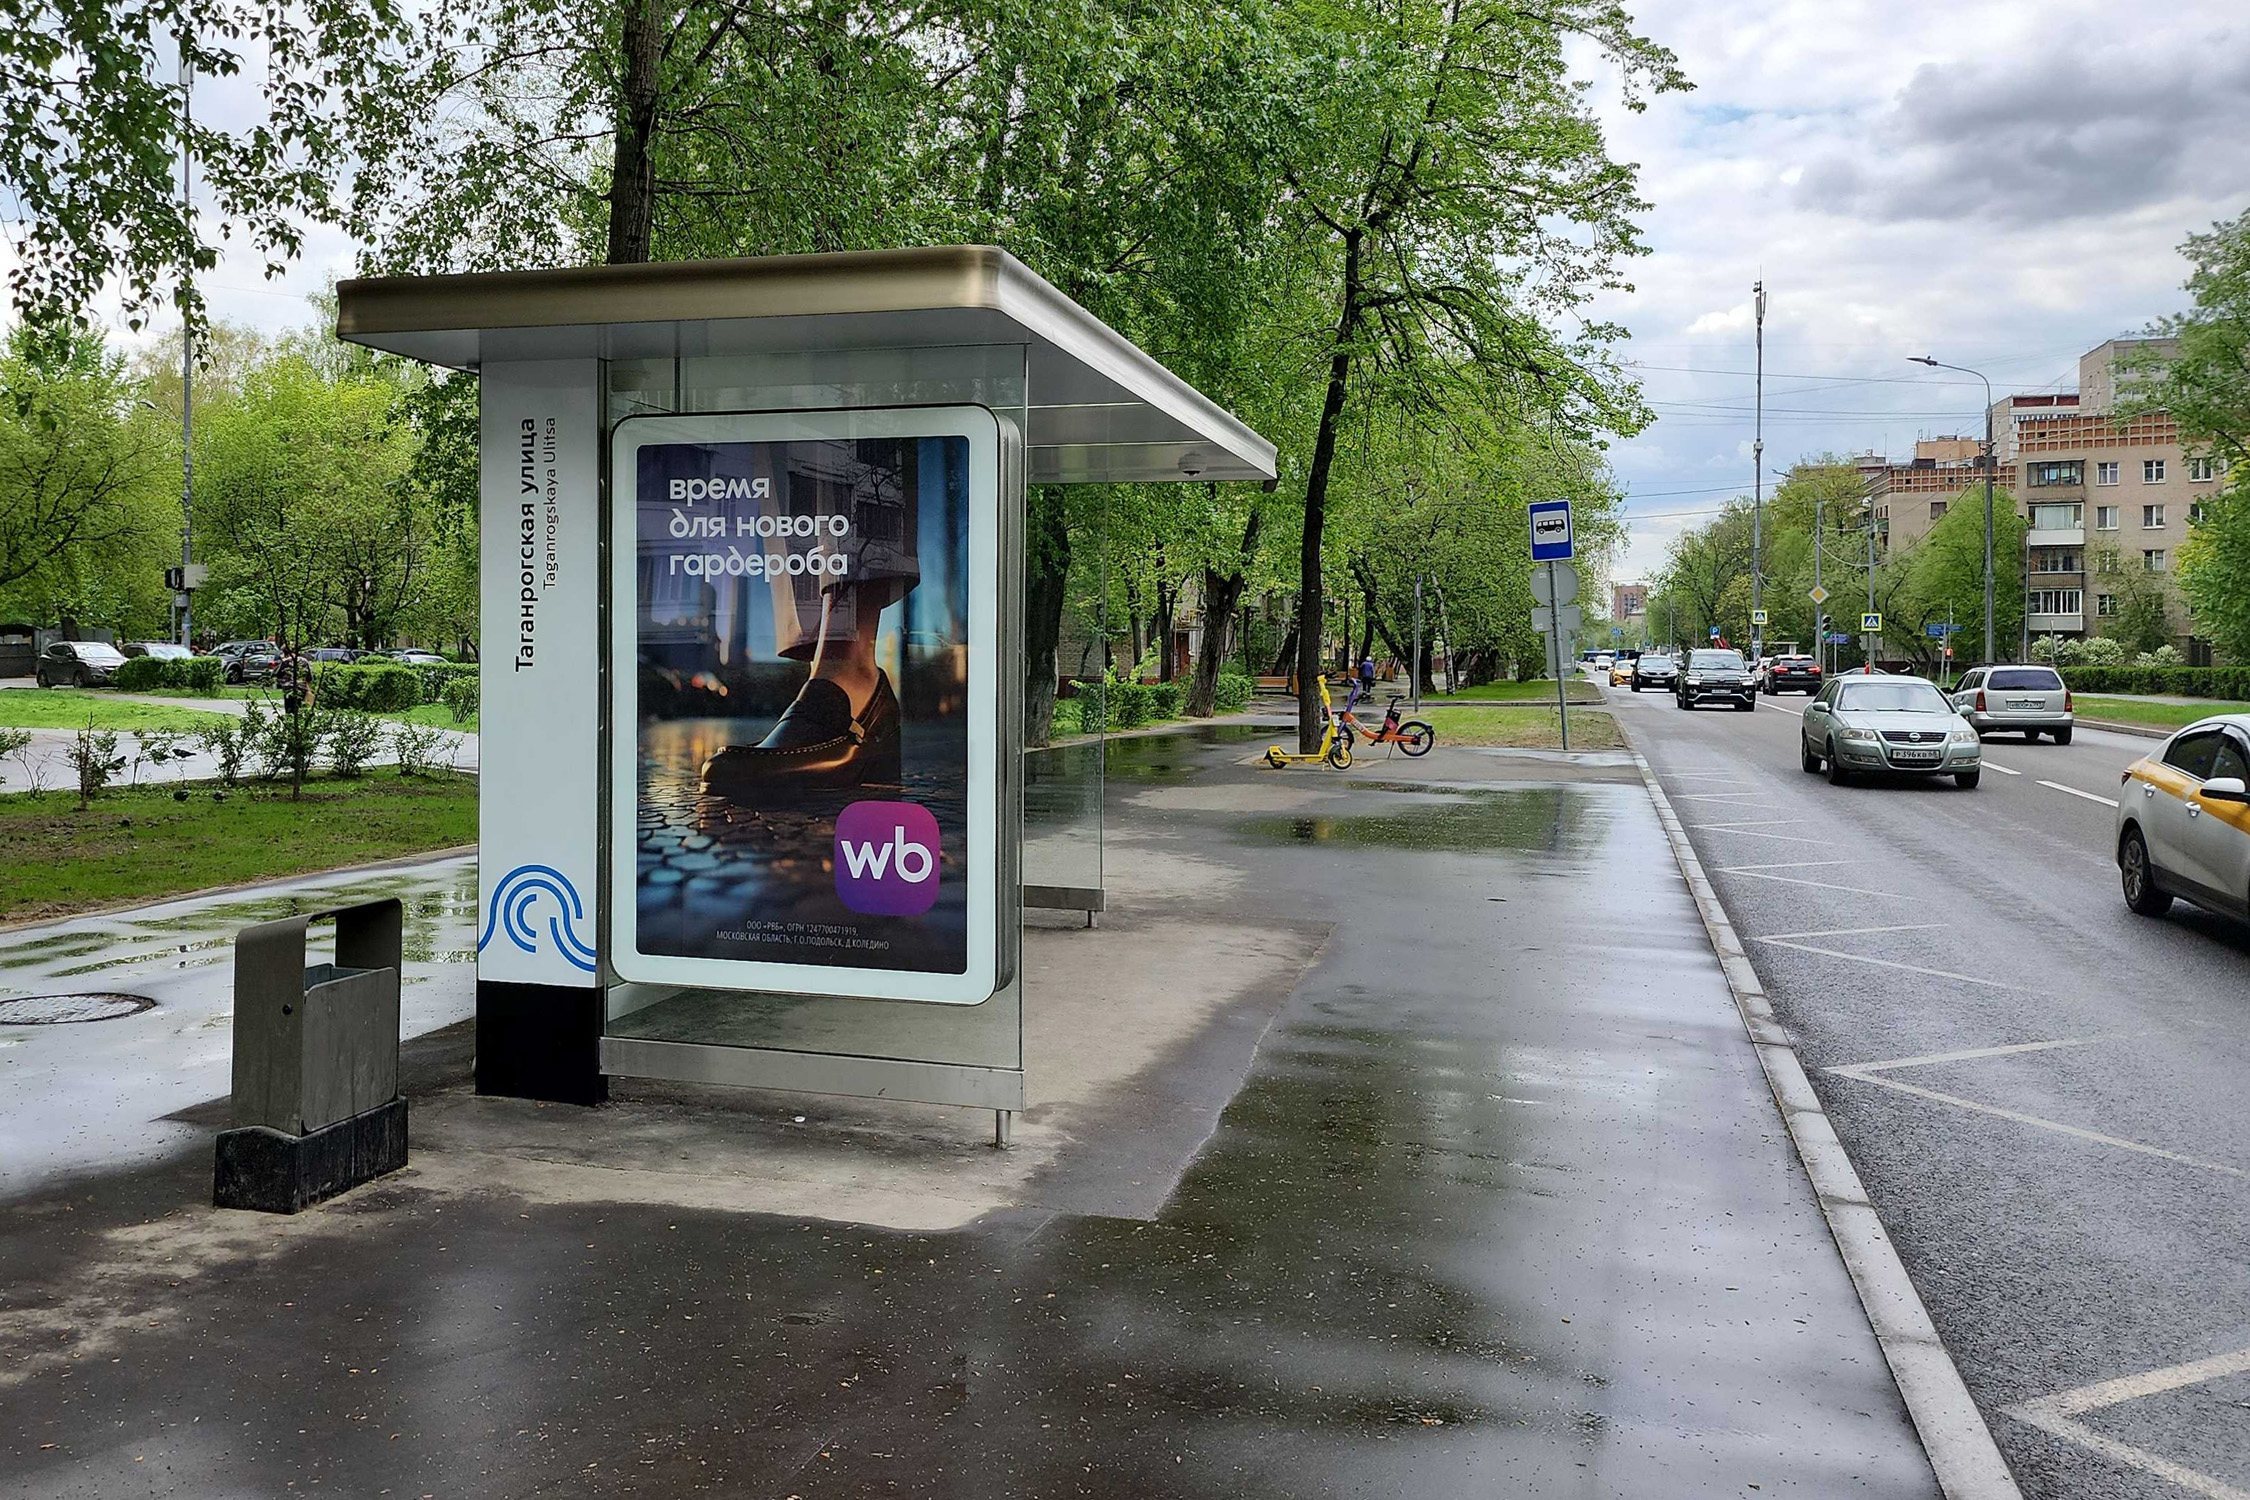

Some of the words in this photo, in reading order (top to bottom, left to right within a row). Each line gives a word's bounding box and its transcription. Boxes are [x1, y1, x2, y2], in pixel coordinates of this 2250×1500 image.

[521, 418, 539, 494] улица
[543, 417, 556, 463] Ulitsa
[669, 477, 770, 506] время
[543, 468, 559, 590] Taganrogskaya
[669, 508, 726, 538] для
[737, 514, 849, 537] нового
[669, 545, 848, 582] гардероба
[515, 503, 538, 672] Таганрогская
[840, 826, 933, 883] wb
[716, 930, 761, 941] МОСКОВСКАЯ
[746, 920, 762, 929] ООО
[787, 922, 804, 932] ОГРН
